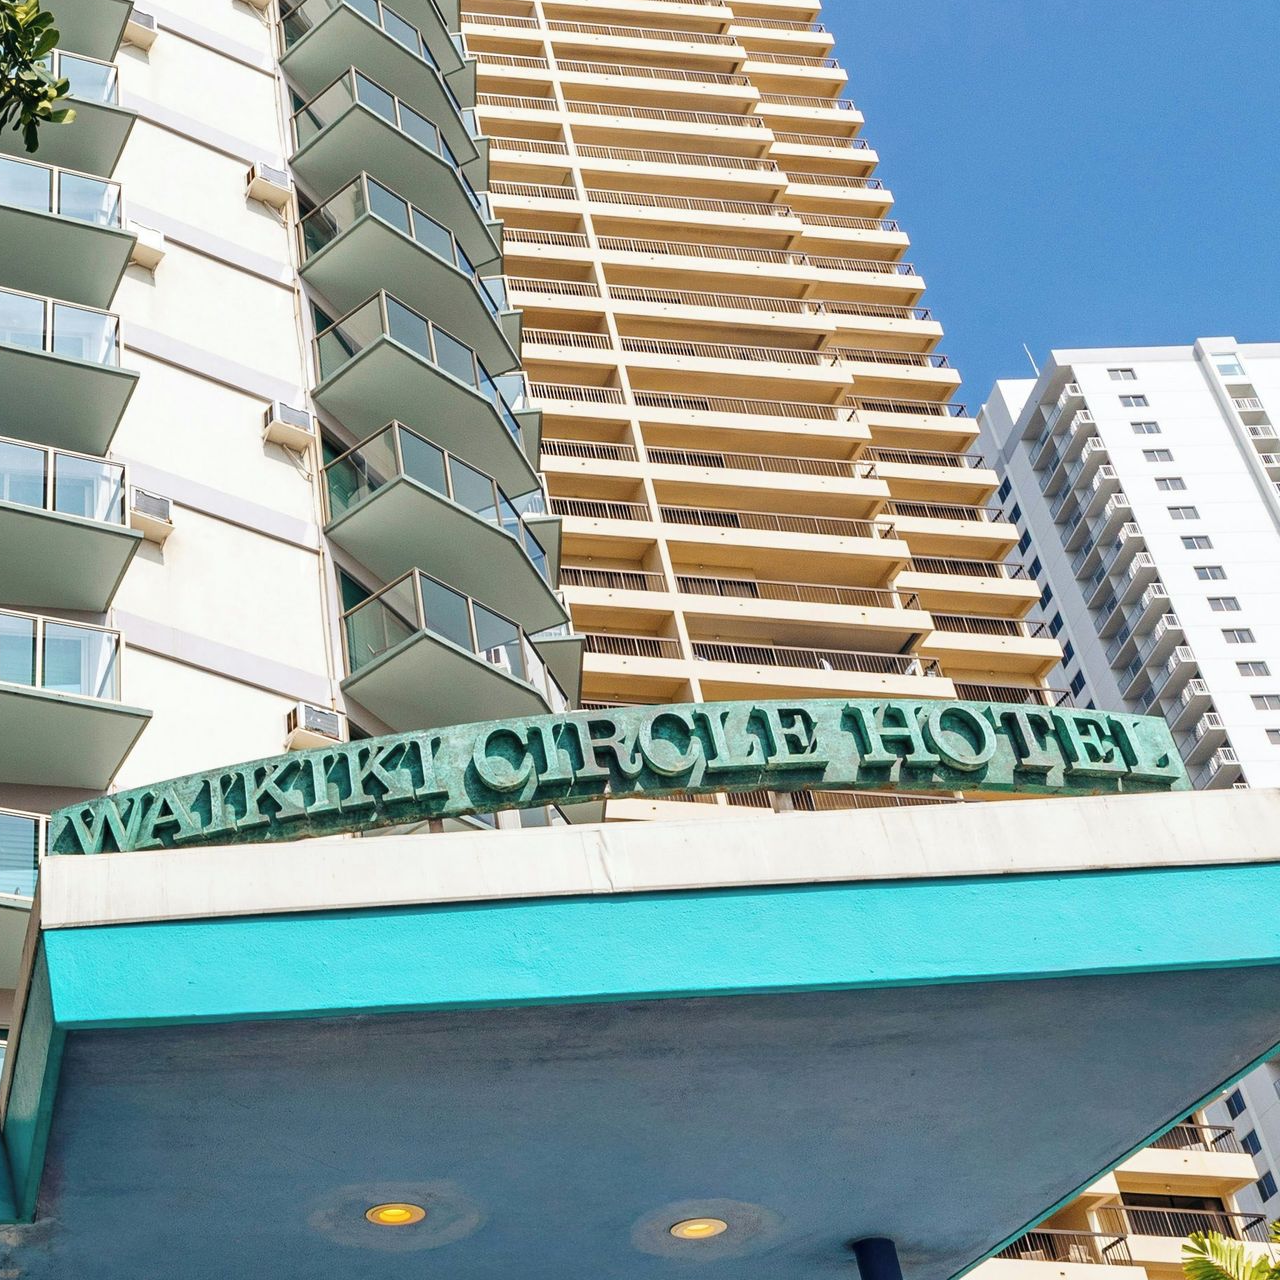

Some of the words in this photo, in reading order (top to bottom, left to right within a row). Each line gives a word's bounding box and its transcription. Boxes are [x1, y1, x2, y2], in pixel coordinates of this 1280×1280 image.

[65, 735, 450, 853] WAIKIKI
[472, 707, 829, 794] CIRCLE
[848, 703, 1181, 785] HOTEL
